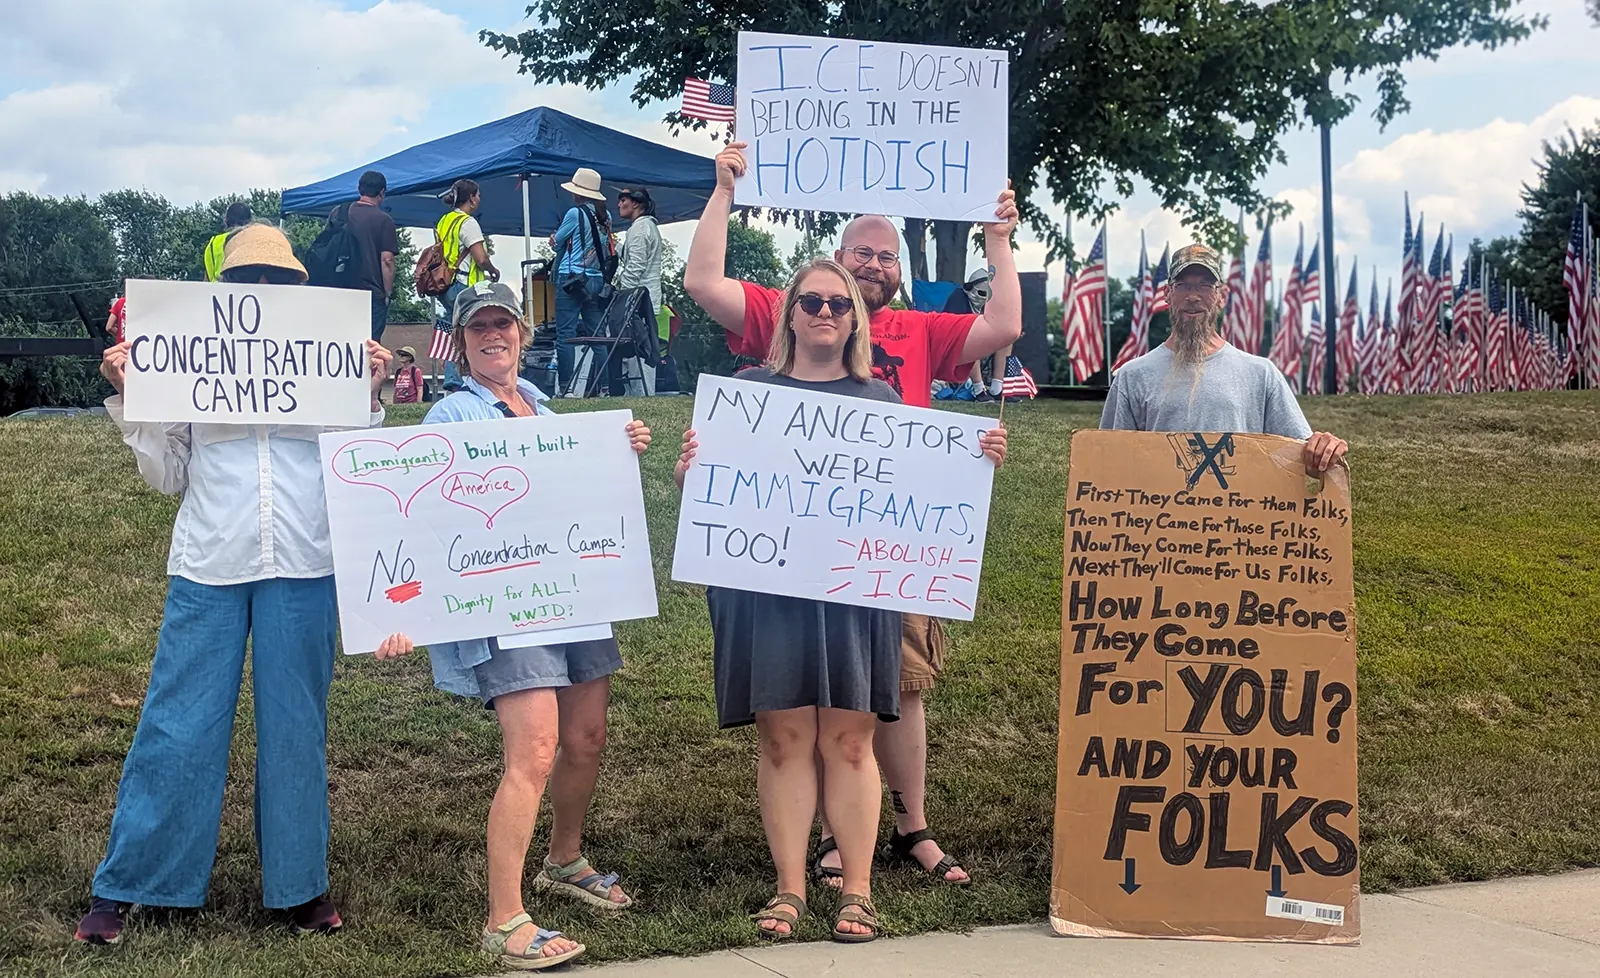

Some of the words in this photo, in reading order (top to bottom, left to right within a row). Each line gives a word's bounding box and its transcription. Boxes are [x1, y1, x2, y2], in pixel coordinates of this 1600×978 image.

[749, 44, 880, 94] I.C.E.
[898, 50, 1006, 91] DOESN'T
[751, 98, 851, 137] BELONG
[866, 101, 896, 127] IN
[912, 100, 961, 125] THE
[756, 136, 970, 196] HOTDISH
[211, 293, 262, 335] NO
[130, 335, 365, 380] CONCENTRATION
[192, 377, 298, 413] CAMPS
[707, 387, 771, 434] MY
[783, 401, 988, 459] ANCESTORS
[343, 446, 450, 475] Immigrants
[463, 440, 508, 460] build
[536, 433, 579, 454] built
[793, 448, 894, 484] WERE
[447, 475, 515, 499] America
[693, 462, 974, 544] IMMIGRANTS,
[1076, 481, 1124, 503] First
[1125, 489, 1171, 509] They
[1174, 491, 1223, 507] Came
[1229, 492, 1255, 508] For
[1259, 495, 1296, 512] them
[1303, 498, 1348, 527] Folks,
[692, 521, 790, 567] TOO!
[1067, 507, 1107, 527] Then
[1111, 511, 1153, 535] They
[1156, 513, 1199, 531] Came
[1202, 517, 1223, 533] For
[1224, 515, 1265, 534] those
[1270, 520, 1321, 542] Folks,
[367, 539, 415, 603] No
[447, 534, 559, 573] Concentration
[566, 516, 626, 556] Camps!
[857, 537, 953, 566] ABOLISH
[1070, 530, 1112, 552] Now
[1111, 533, 1152, 560] They
[1155, 537, 1203, 554] Come
[1205, 538, 1232, 558] For
[1233, 538, 1278, 556] these
[1283, 542, 1332, 564] Folks,
[863, 569, 951, 604] I.C.E.
[1067, 556, 1120, 577] Next
[1120, 557, 1172, 581] They'll
[1173, 560, 1213, 576] Come
[1214, 562, 1241, 580] For
[1245, 563, 1271, 580] Us
[1278, 565, 1333, 585] Folks,
[442, 594, 494, 616] Dignity
[504, 585, 523, 600] for
[530, 573, 580, 598] ALL!
[1069, 580, 1142, 621] How
[1150, 586, 1229, 629] Long
[1235, 590, 1348, 632] Before
[1071, 623, 1148, 664] They
[1154, 623, 1261, 659] Come
[1075, 662, 1164, 716] For
[1177, 663, 1352, 744] YOU?
[1077, 736, 1171, 780] AND
[1185, 744, 1298, 790] YOUR
[1103, 785, 1358, 877] FOLKS
